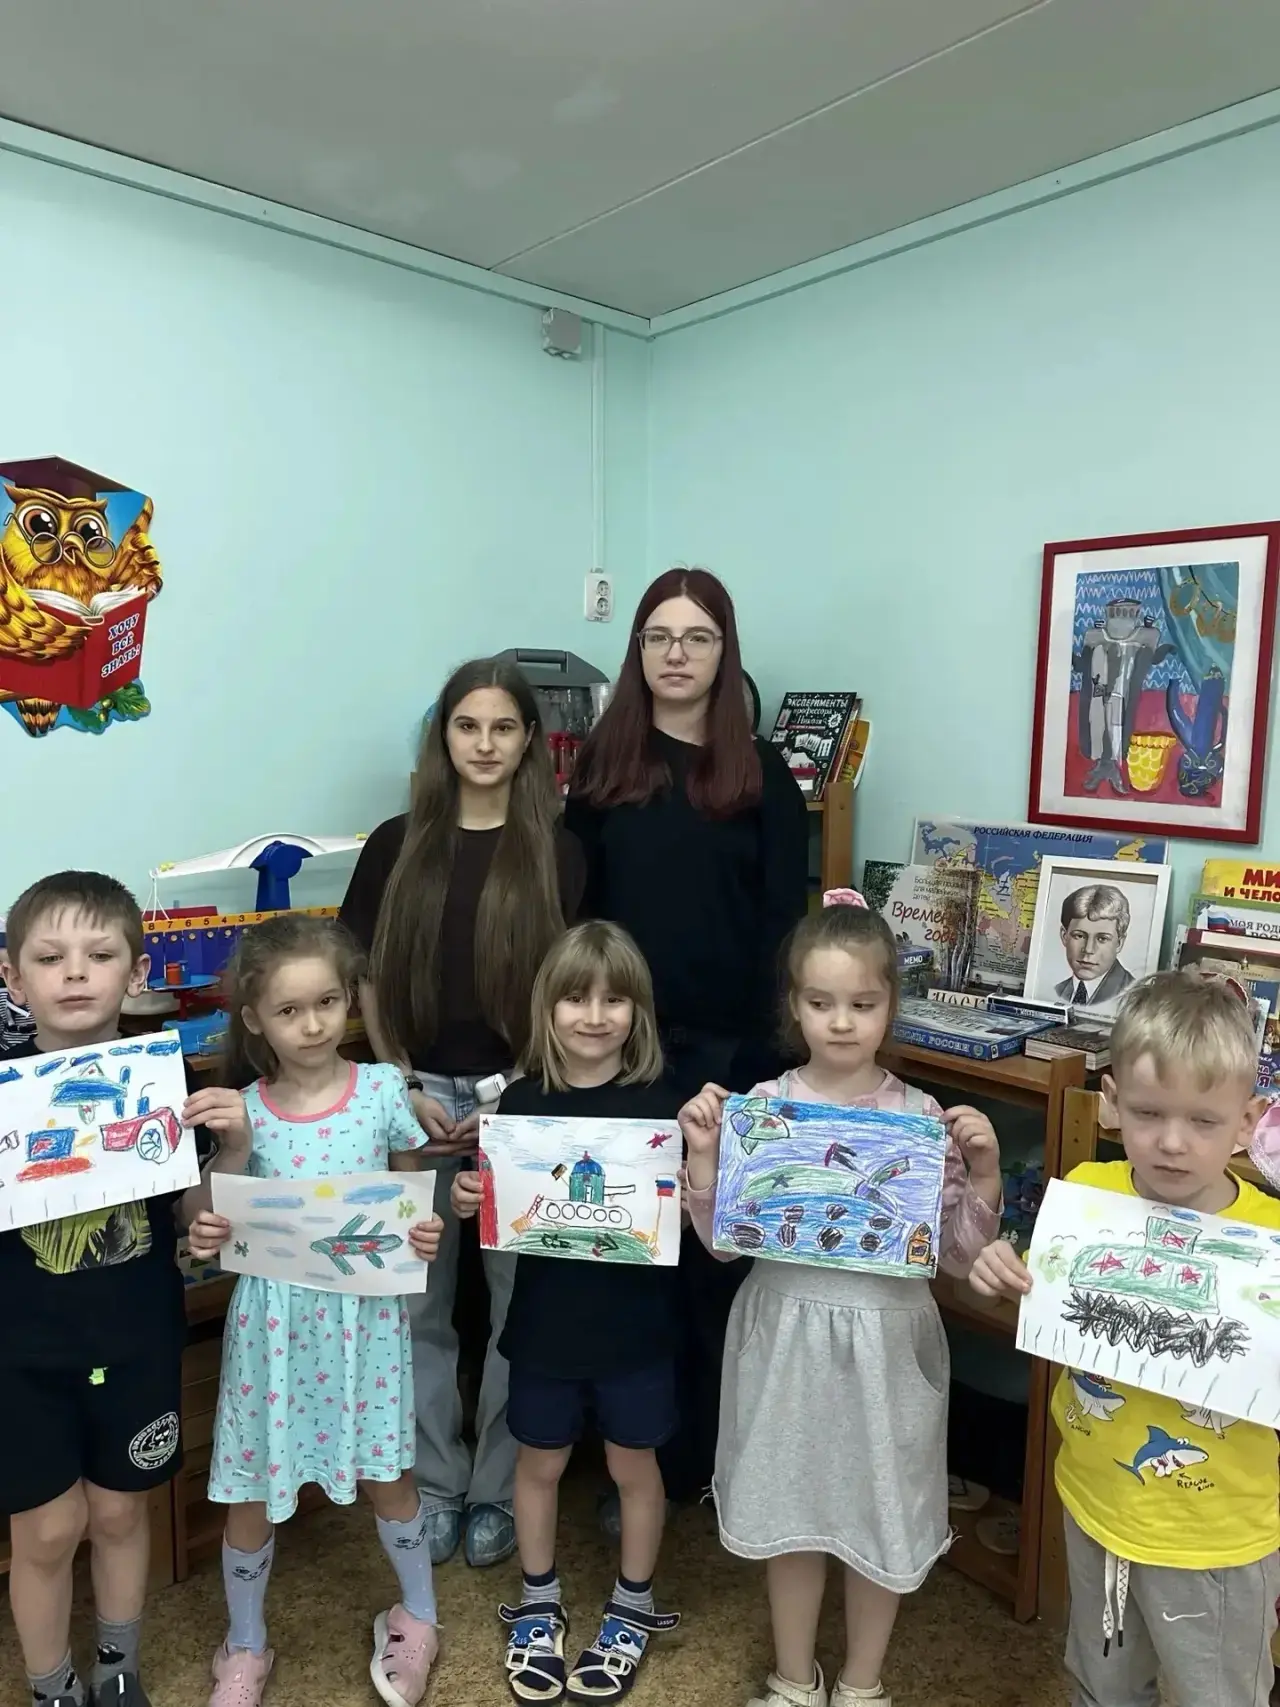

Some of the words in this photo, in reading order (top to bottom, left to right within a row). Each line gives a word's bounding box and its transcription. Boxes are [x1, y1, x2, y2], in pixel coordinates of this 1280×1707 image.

[108, 613, 140, 641] ХОЧУ
[101, 643, 141, 678] ЗНАТЬ!
[787, 698, 849, 708] ЭКСПЕРИМЕНТЫ
[973, 826, 1032, 839] РОССИЙСКАЯ
[1032, 830, 1094, 844] ФЕДЕРАЦИЯ
[1223, 886, 1236, 898] И
[148, 922, 155, 931] 8
[167, 920, 174, 929] 7
[185, 919, 192, 928] 6
[203, 917, 210, 926] 5
[221, 916, 228, 924] 4
[238, 914, 245, 923] 3
[1229, 918, 1254, 930] МОЯ
[1256, 921, 1280, 934] РОД
[928, 1034, 970, 1053] РОССИИ
